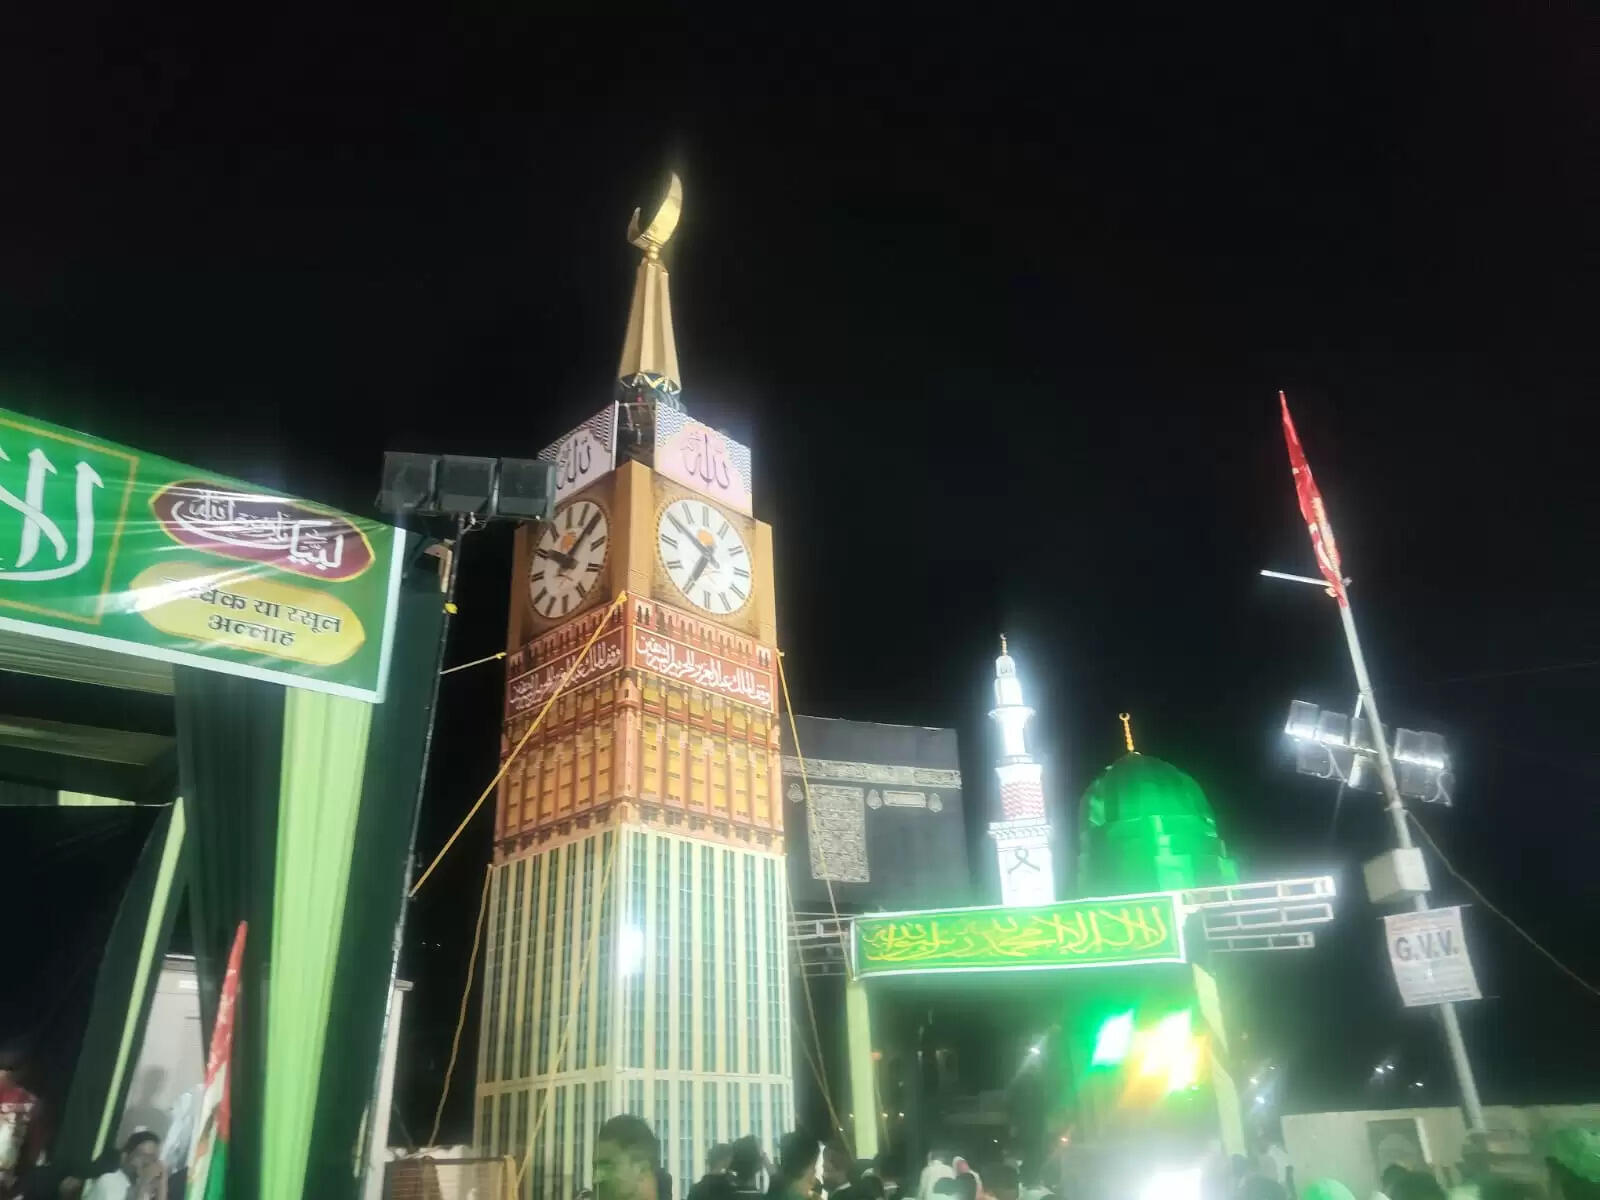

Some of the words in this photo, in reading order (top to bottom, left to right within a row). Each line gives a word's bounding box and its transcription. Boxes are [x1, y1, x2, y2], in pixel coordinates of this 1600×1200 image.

[207, 614, 297, 647] अल्लाह
[253, 598, 281, 618] या
[286, 606, 342, 634] रसूल
